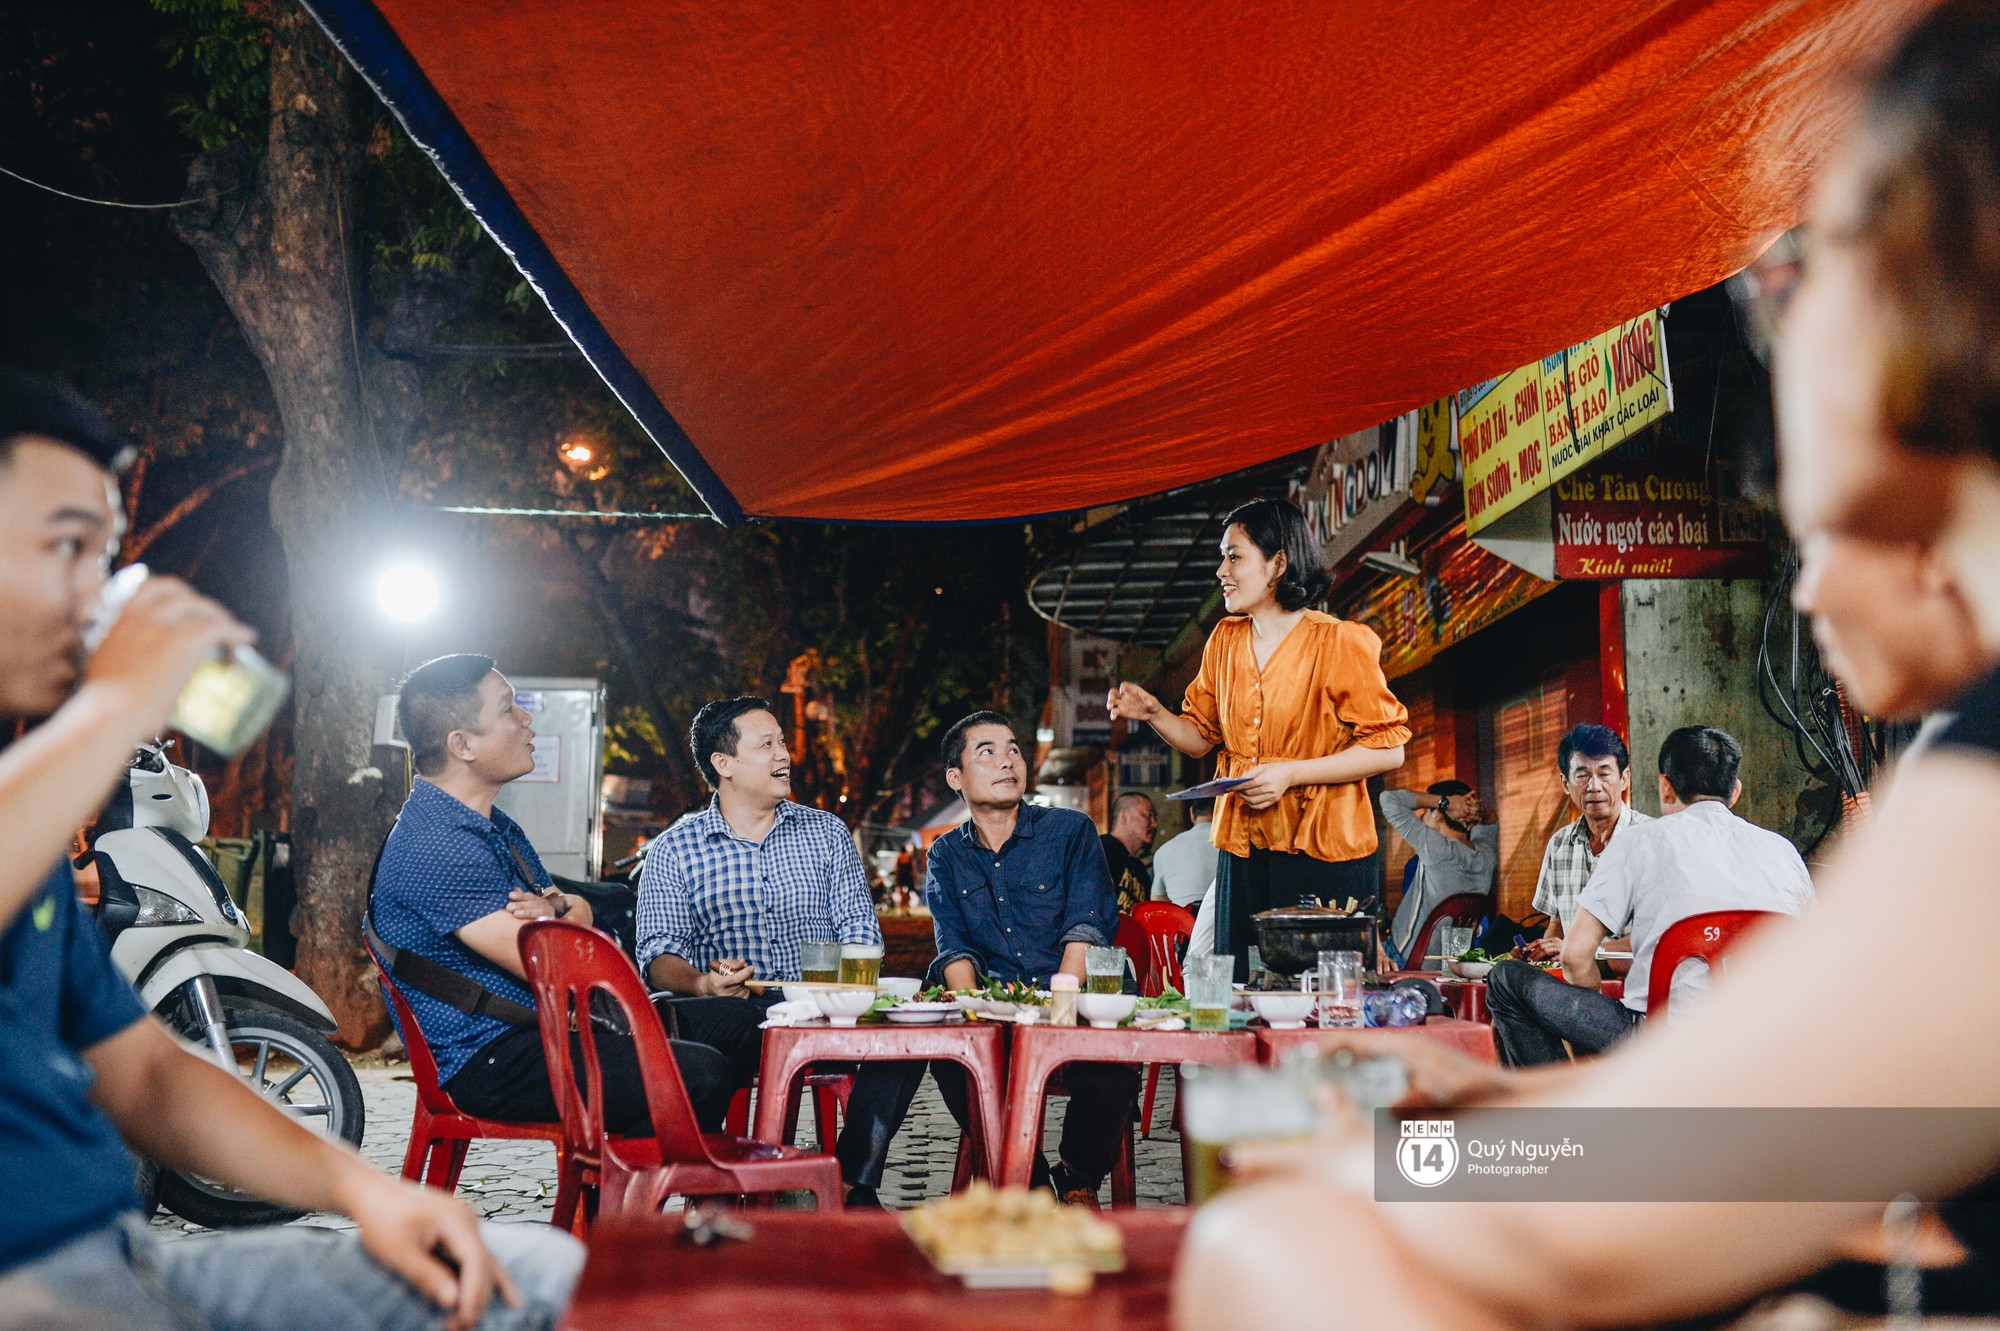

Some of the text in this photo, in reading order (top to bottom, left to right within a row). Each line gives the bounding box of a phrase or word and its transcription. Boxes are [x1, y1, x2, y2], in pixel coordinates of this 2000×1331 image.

[1545, 370, 1577, 413] BÁNH
[1578, 347, 1600, 388] GIÒ
[1611, 317, 1656, 396] NÓNG
[1463, 377, 1539, 468] PHỞ BÒ TÁI CHÍN
[1549, 387, 1607, 447] BÁNH BAO
[1617, 403, 1636, 426] CÁC
[1637, 386, 1660, 413] LOẠI
[1468, 439, 1542, 519] BÚN SƯỜN MỌC
[1600, 472, 1640, 501] Tân
[1557, 511, 1602, 546] Nước
[1606, 515, 1644, 554] ngọt
[1648, 511, 1674, 545] các
[1677, 512, 1709, 551] loại
[1703, 926, 1721, 942] 59
